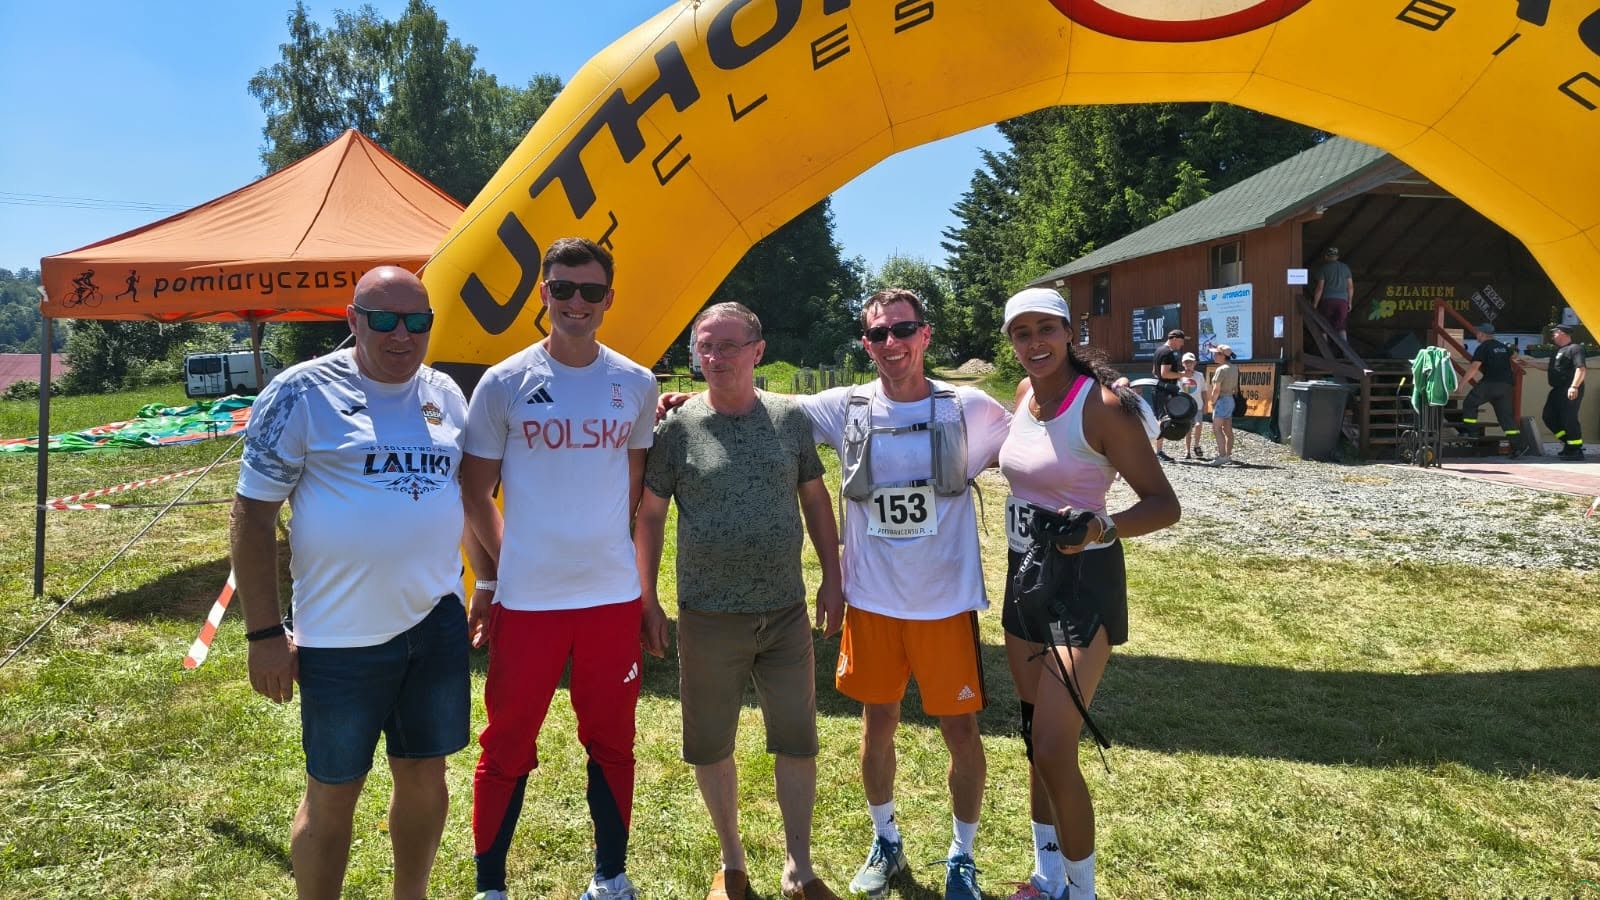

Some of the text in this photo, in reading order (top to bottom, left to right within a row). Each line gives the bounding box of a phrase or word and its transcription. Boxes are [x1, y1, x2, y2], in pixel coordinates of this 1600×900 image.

[1385, 285, 1456, 298] SZLAKIEM
[522, 418, 632, 449] POLSKA
[363, 452, 451, 476] LALIKI
[874, 493, 928, 525] 153
[1009, 504, 1031, 538] 15
